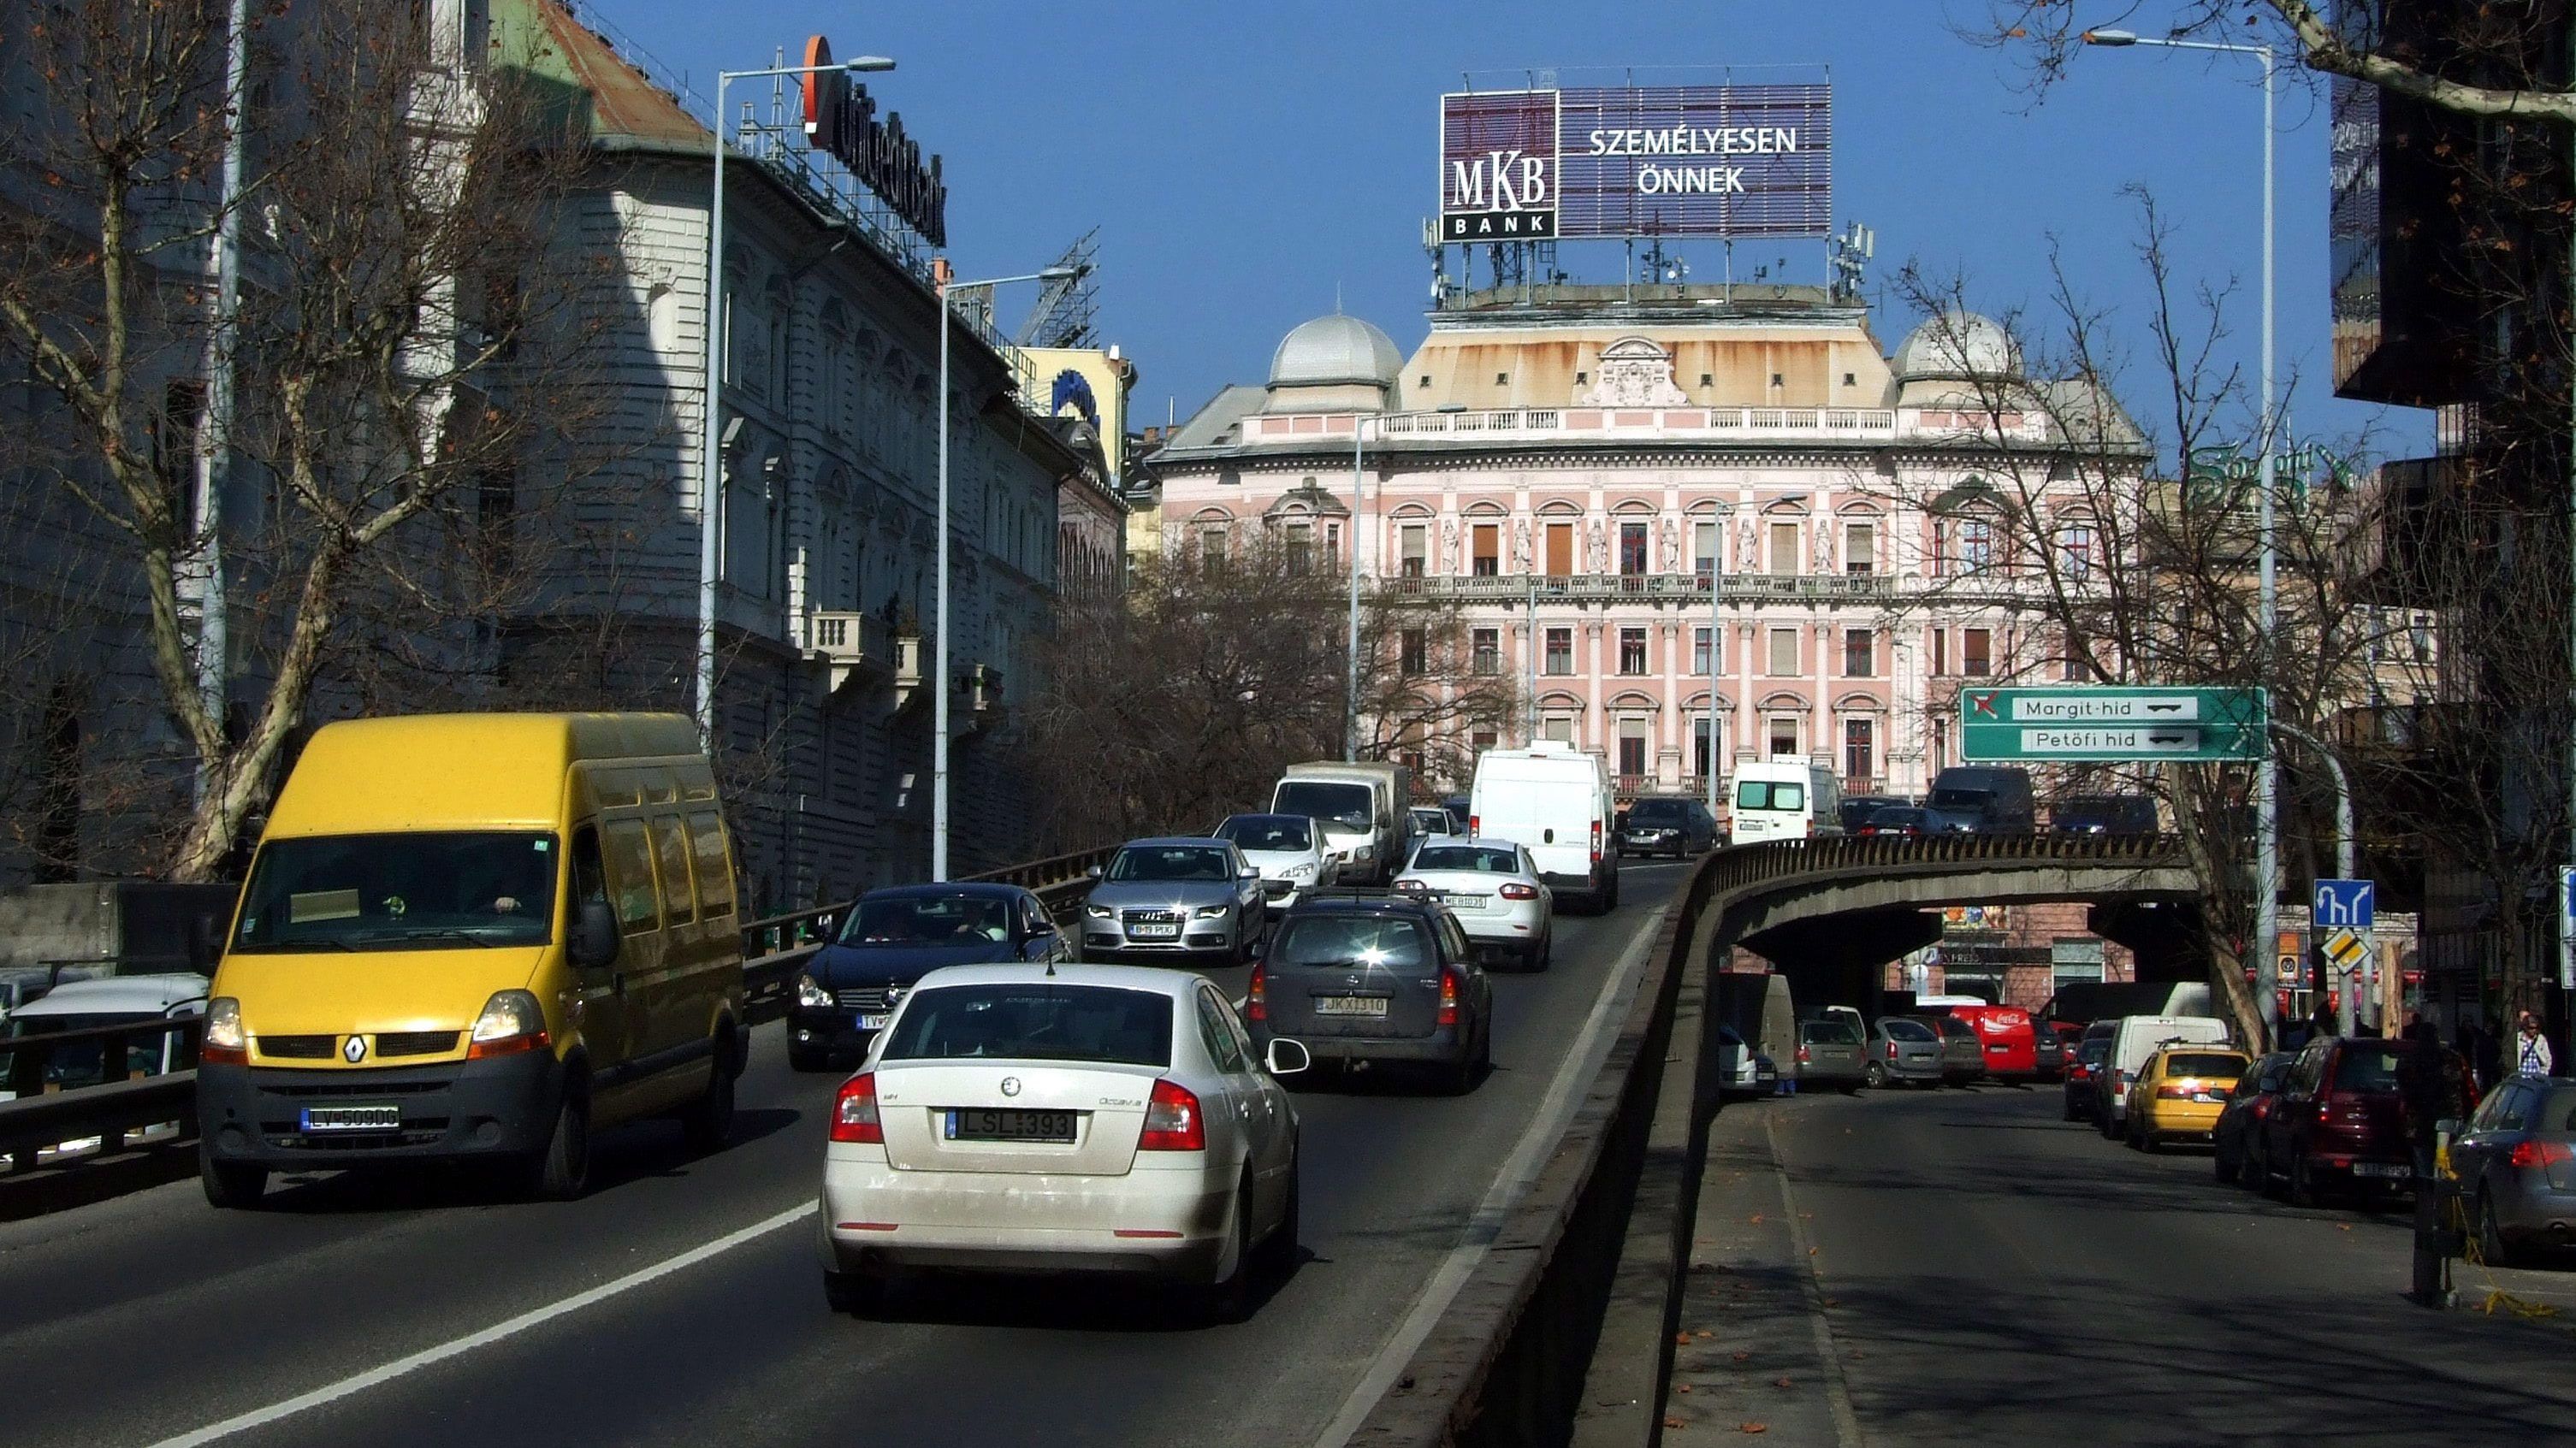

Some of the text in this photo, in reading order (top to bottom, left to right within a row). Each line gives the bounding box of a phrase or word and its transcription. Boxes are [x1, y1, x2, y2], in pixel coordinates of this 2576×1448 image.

[1589, 125, 1797, 157] SZEMÉLYESEN
[1453, 151, 1546, 212] MKB
[1637, 164, 1744, 194] ÖNNEK
[1455, 216, 1543, 233] BANK
